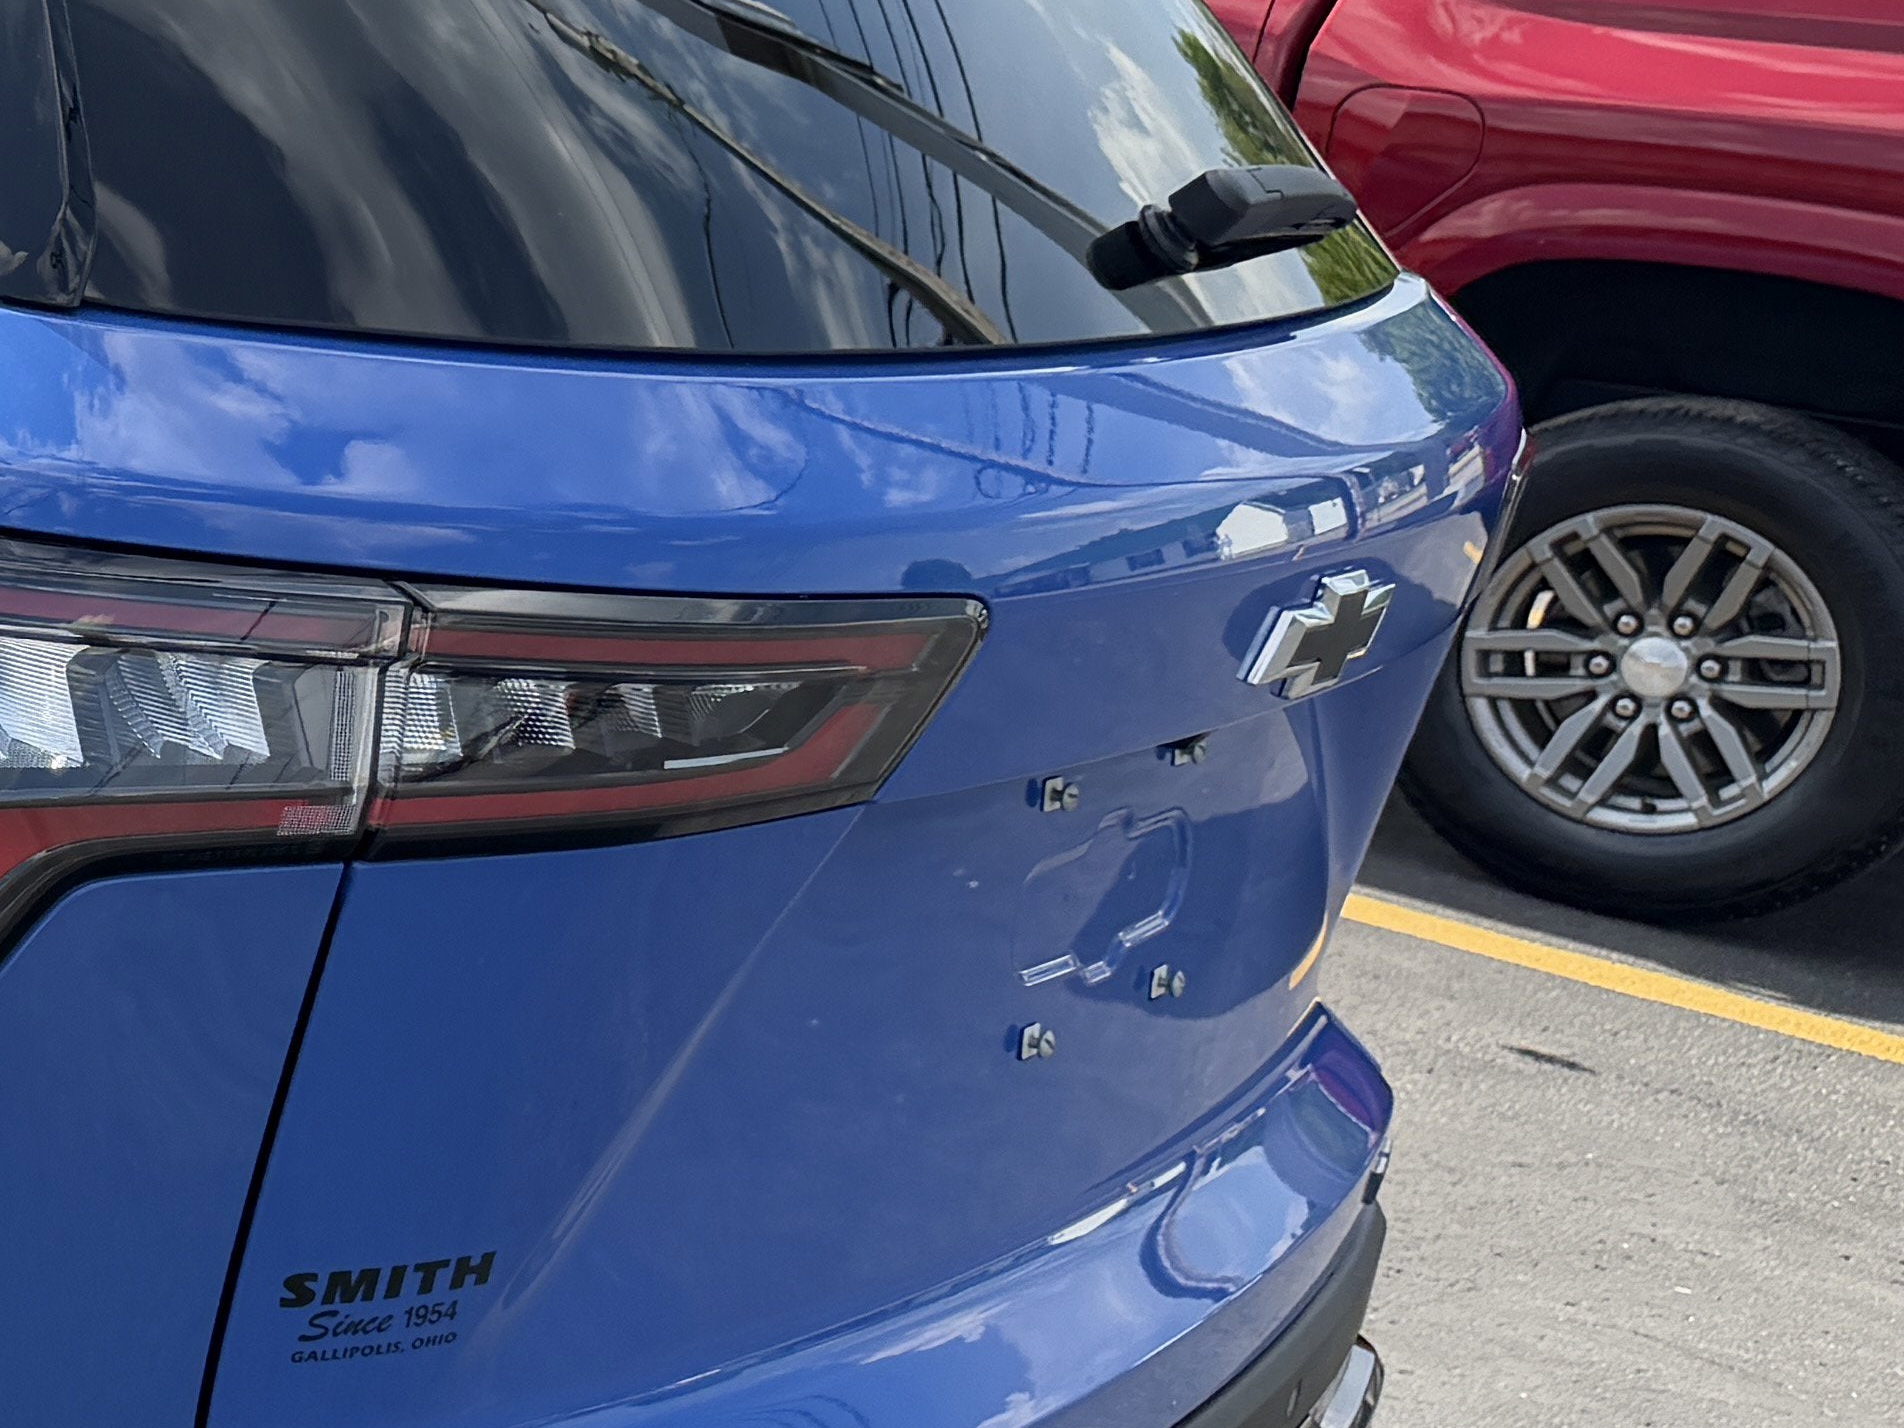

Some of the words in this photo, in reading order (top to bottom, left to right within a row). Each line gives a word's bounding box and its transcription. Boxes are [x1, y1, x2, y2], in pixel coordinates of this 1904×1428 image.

[279, 1251, 497, 1308] SMITH
[297, 1310, 394, 1342] Since
[404, 1299, 459, 1328] 1954
[291, 1341, 405, 1364] GALLIPOLIS,
[411, 1332, 458, 1350] OHIO
